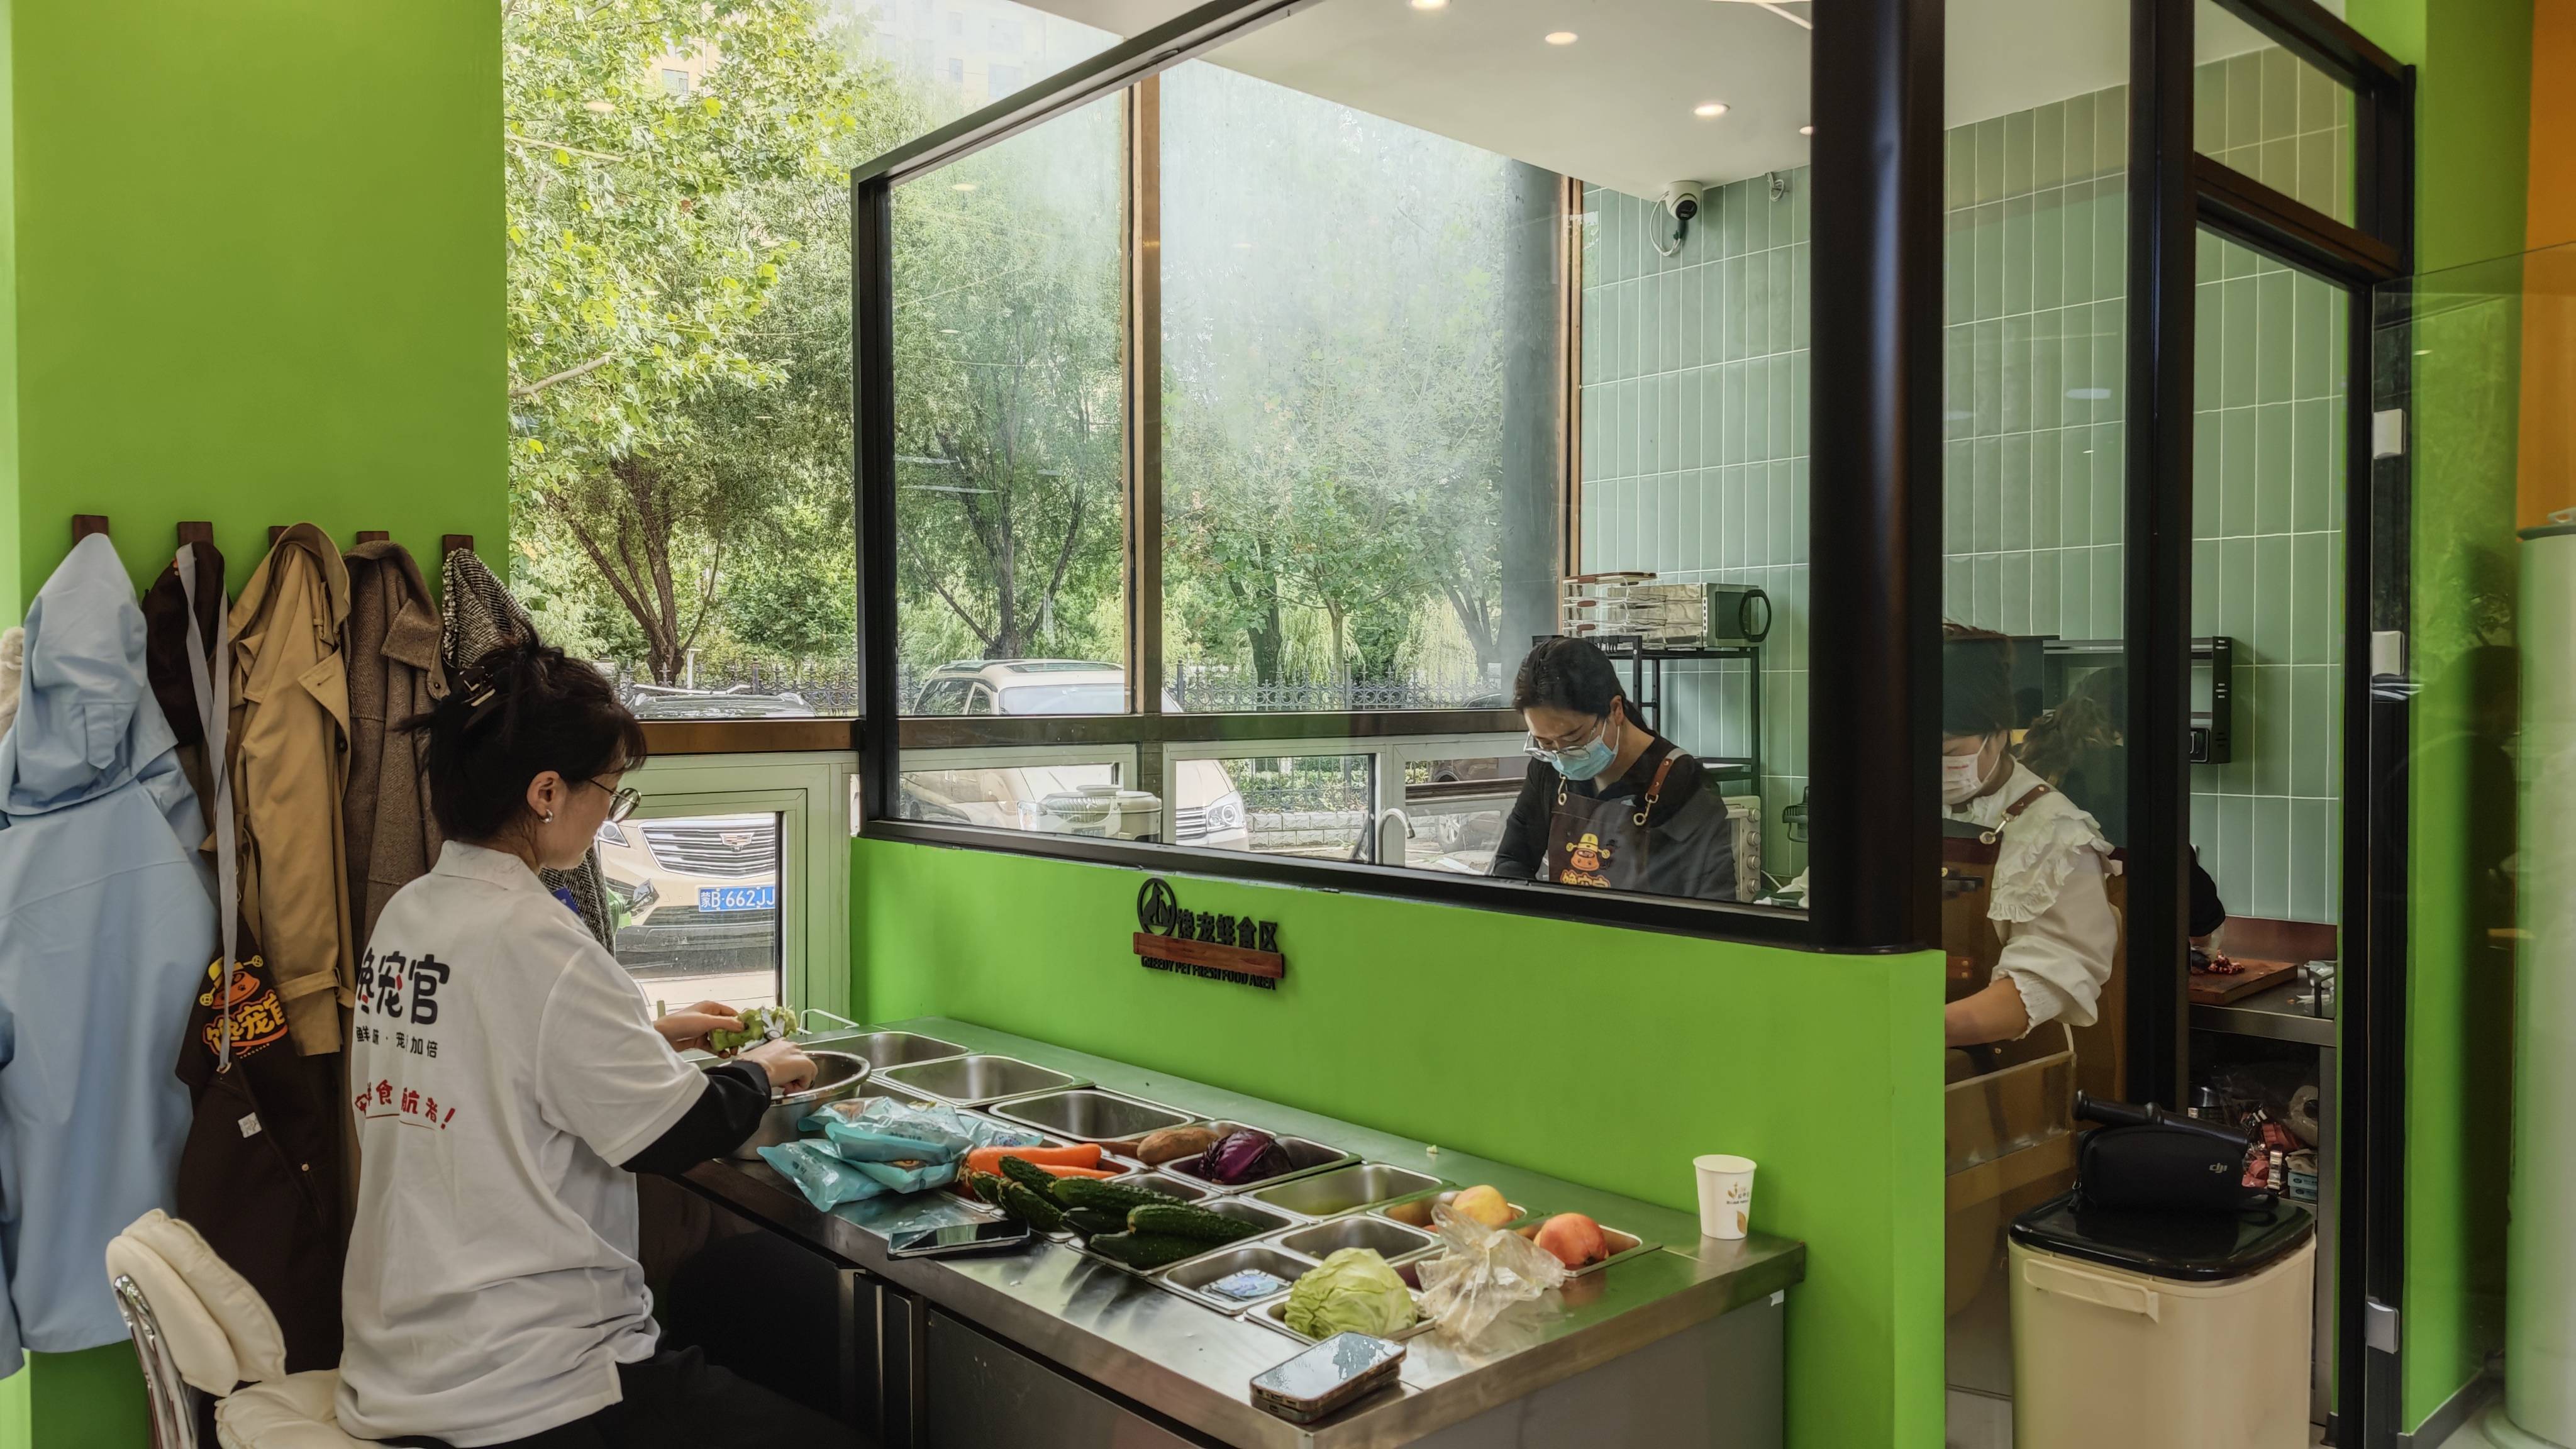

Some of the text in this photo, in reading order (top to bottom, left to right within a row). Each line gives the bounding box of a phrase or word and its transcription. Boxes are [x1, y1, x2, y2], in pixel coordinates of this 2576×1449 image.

[1141, 956, 1276, 991] GREEDY PET FRESH FOOD AREA
